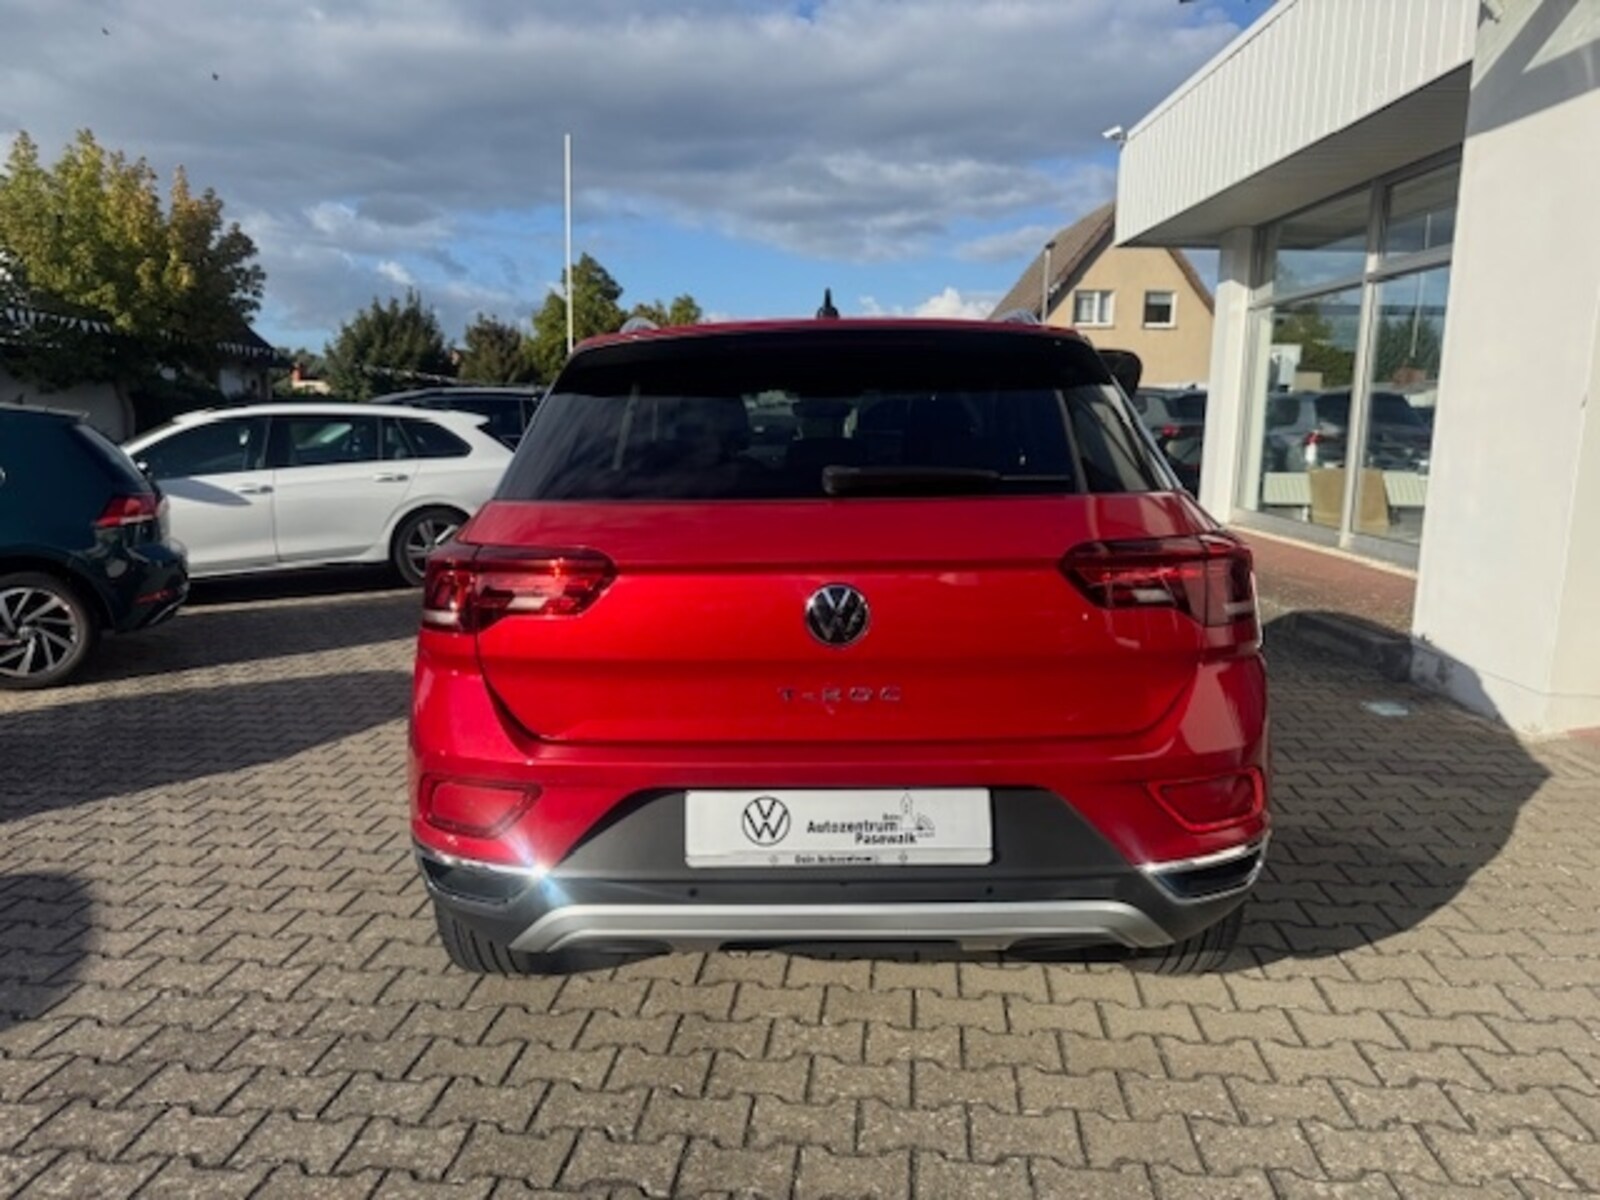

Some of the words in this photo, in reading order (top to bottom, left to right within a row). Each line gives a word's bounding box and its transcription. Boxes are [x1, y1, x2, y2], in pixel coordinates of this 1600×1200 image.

[806, 584, 870, 647] VW
[742, 796, 791, 846] VW
[806, 820, 898, 834] Autozentrum
[855, 832, 917, 844] Pasewalk
